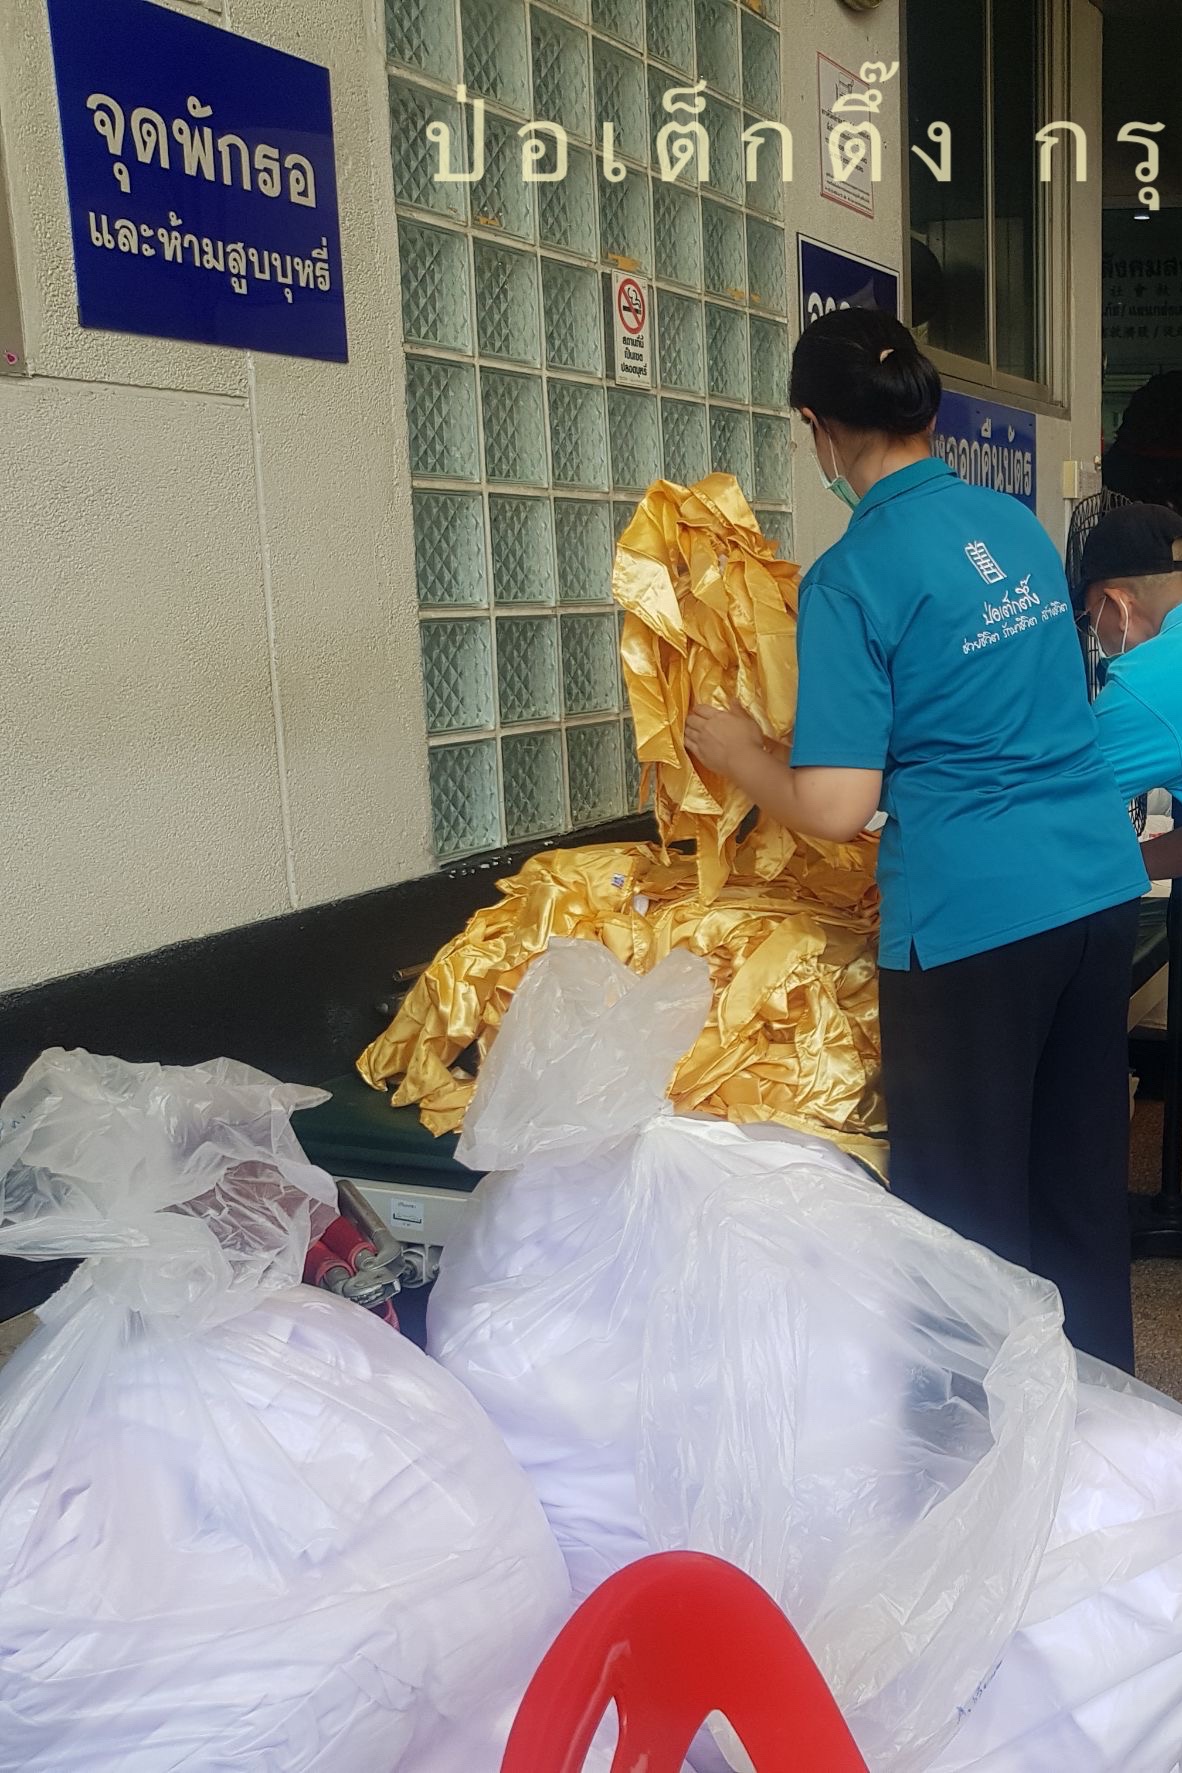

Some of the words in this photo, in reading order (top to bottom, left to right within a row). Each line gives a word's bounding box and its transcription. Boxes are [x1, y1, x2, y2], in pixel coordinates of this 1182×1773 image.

[86, 93, 316, 208] จุดพักรอ
[88, 210, 331, 304] และห้ามสูบบุหรี่
